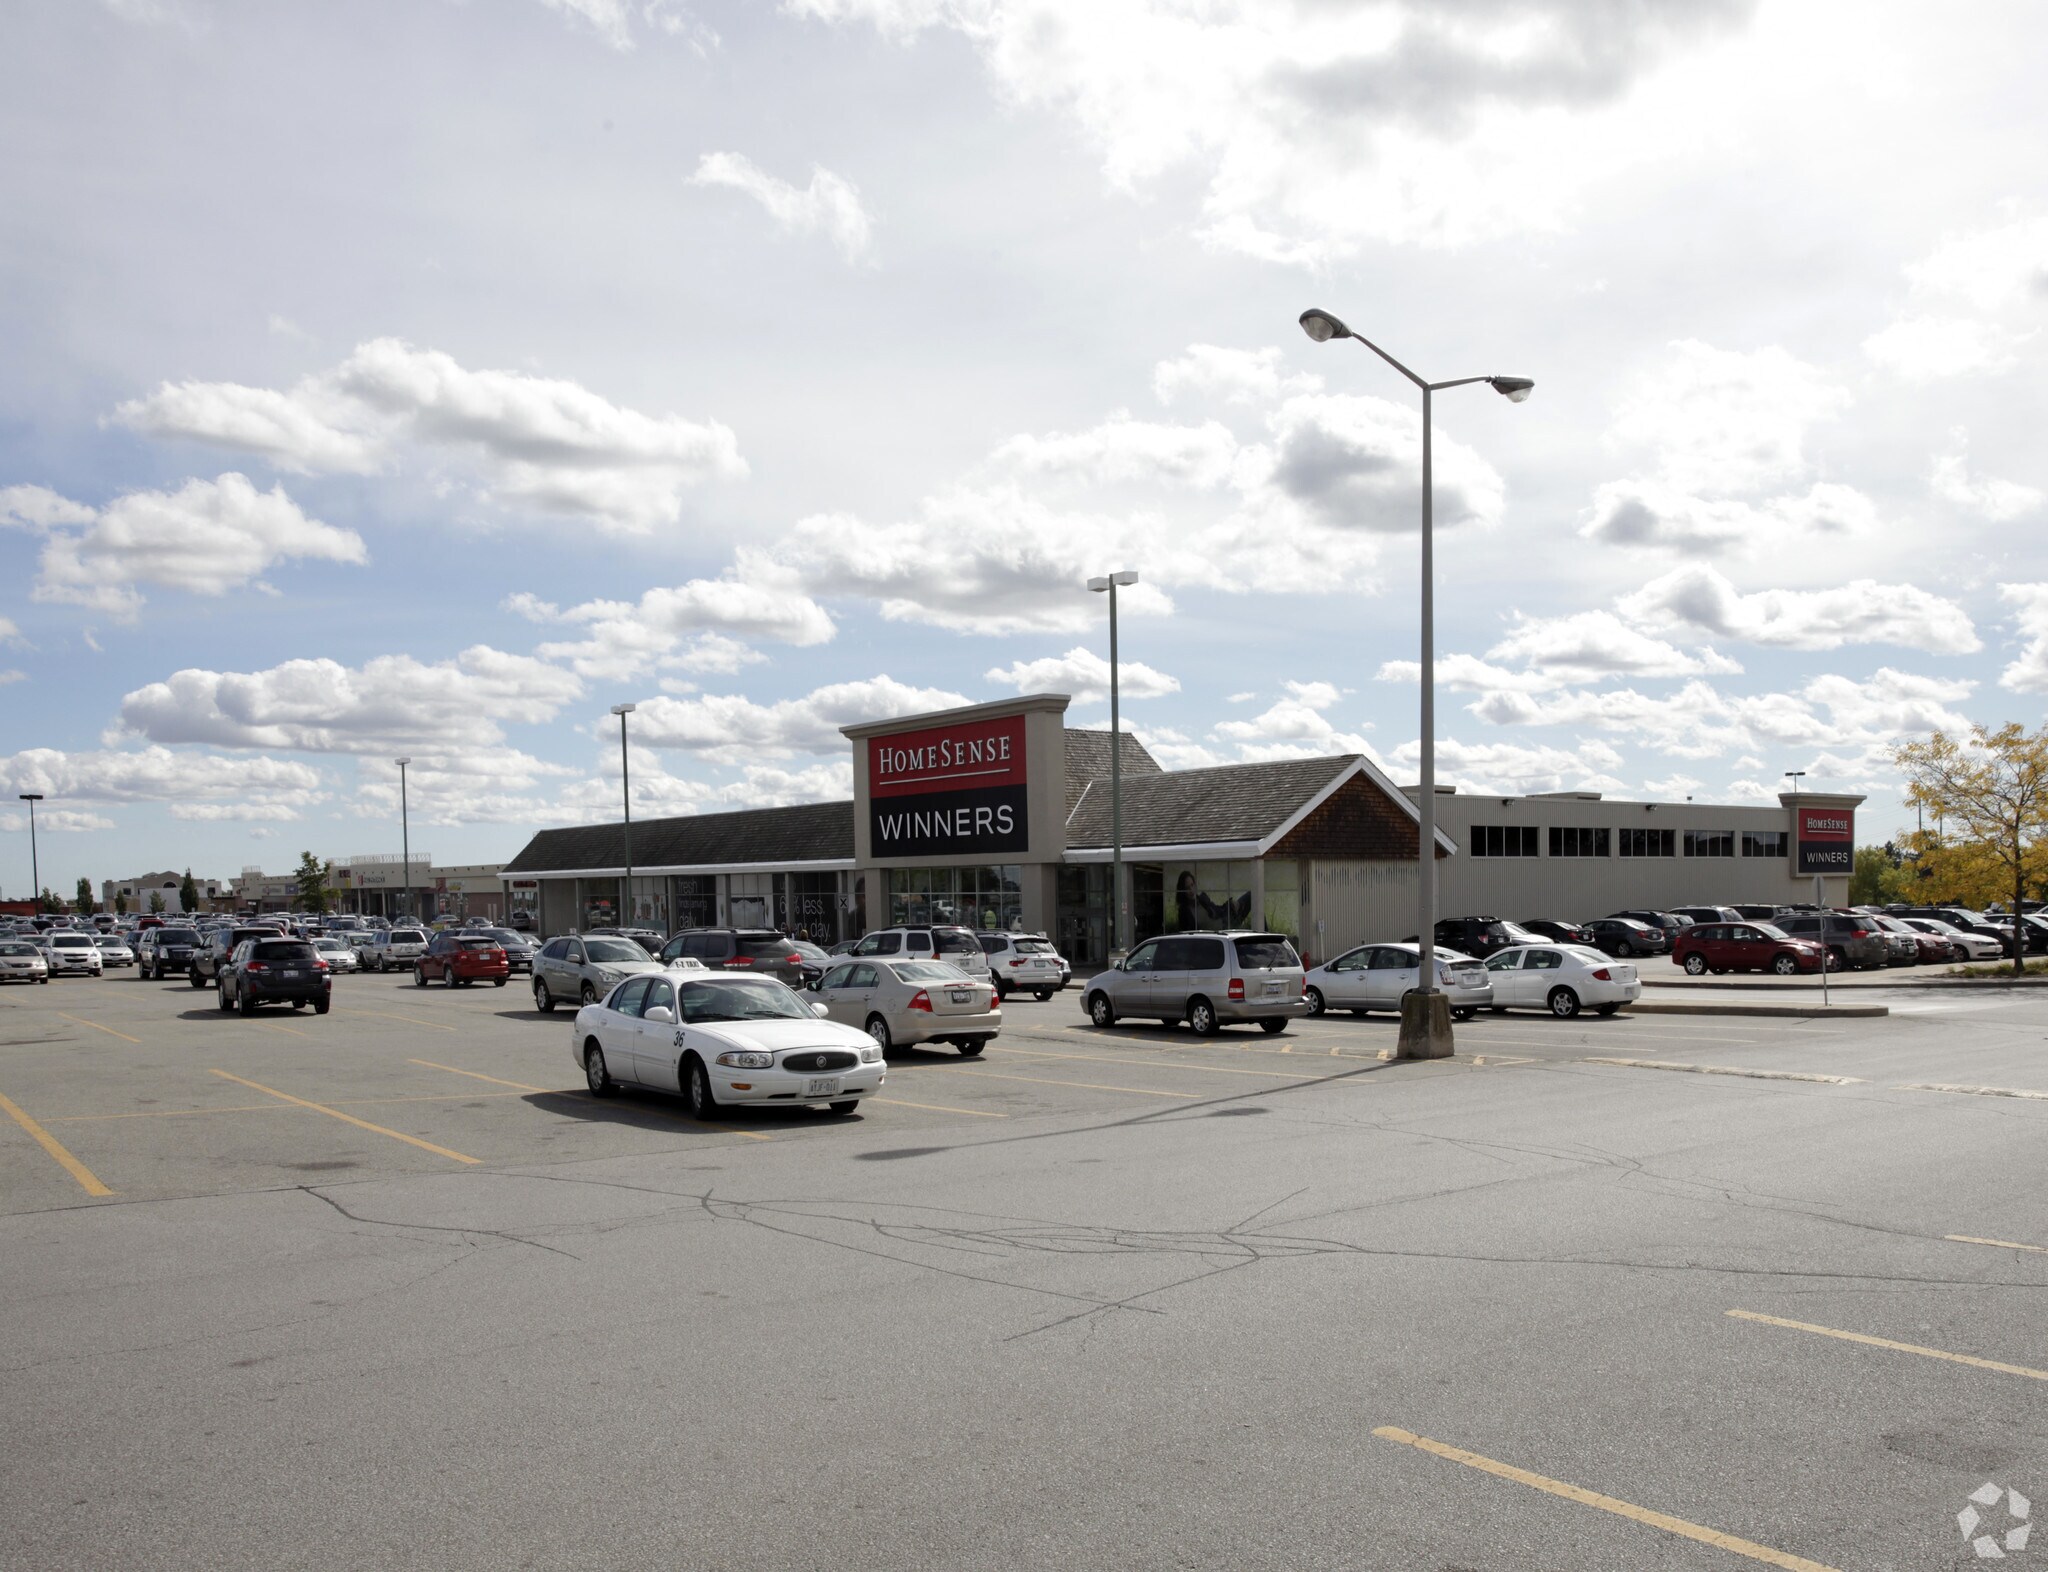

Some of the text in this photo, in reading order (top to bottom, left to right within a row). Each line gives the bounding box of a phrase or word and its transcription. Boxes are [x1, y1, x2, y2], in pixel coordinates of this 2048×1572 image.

[879, 736, 1010, 774] HOMESENSE
[879, 805, 1014, 840] WINNERS
[1806, 852, 1848, 863] WINNERS
[678, 878, 698, 895] fresh
[779, 895, 800, 915] 6%
[685, 960, 700, 968] TAXI
[673, 1030, 686, 1048] 36
